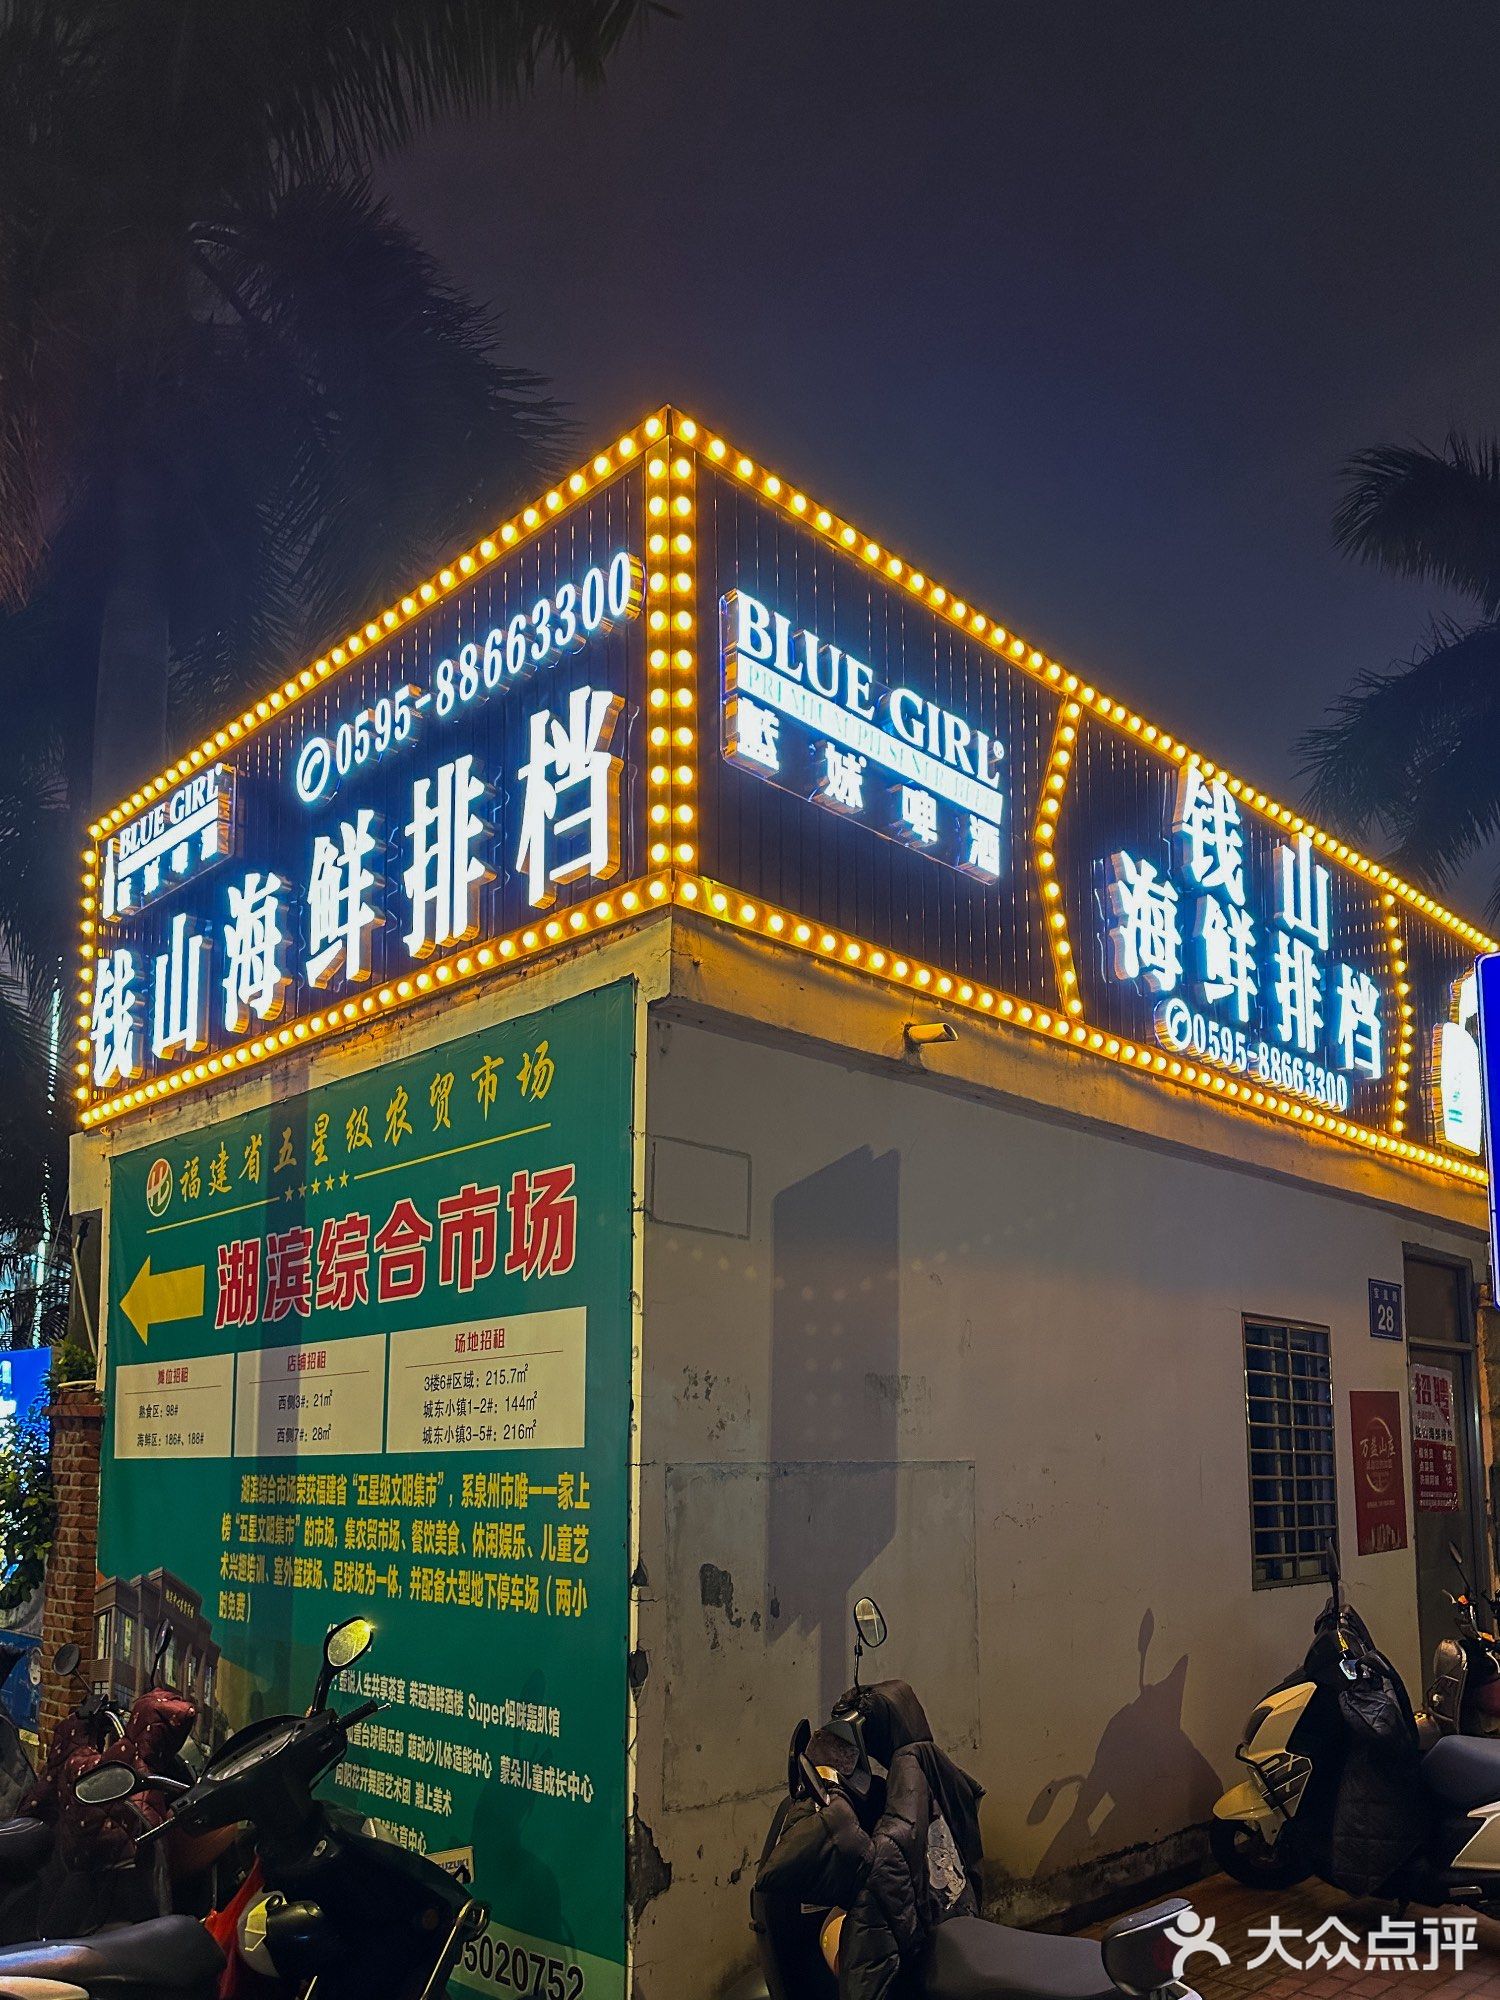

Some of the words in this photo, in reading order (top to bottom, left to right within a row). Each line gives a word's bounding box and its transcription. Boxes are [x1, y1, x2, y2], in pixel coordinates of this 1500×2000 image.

[336, 551, 631, 777] 0595-88663300
[736, 589, 876, 721] BLUE
[119, 802, 166, 862] BLUE
[1117, 850, 1381, 1080] 海鲜排档
[1191, 1013, 1348, 1112] 0595-88663300
[179, 1039, 555, 1202] 福建省五星级农贸市场
[214, 1163, 577, 1330] 湖滨综合市场
[287, 1350, 327, 1372] 店铺招租
[454, 1328, 505, 1353] 场地招租
[1378, 1304, 1394, 1332] 28
[500, 1754, 594, 1803] 蒙朵儿童成长中心
